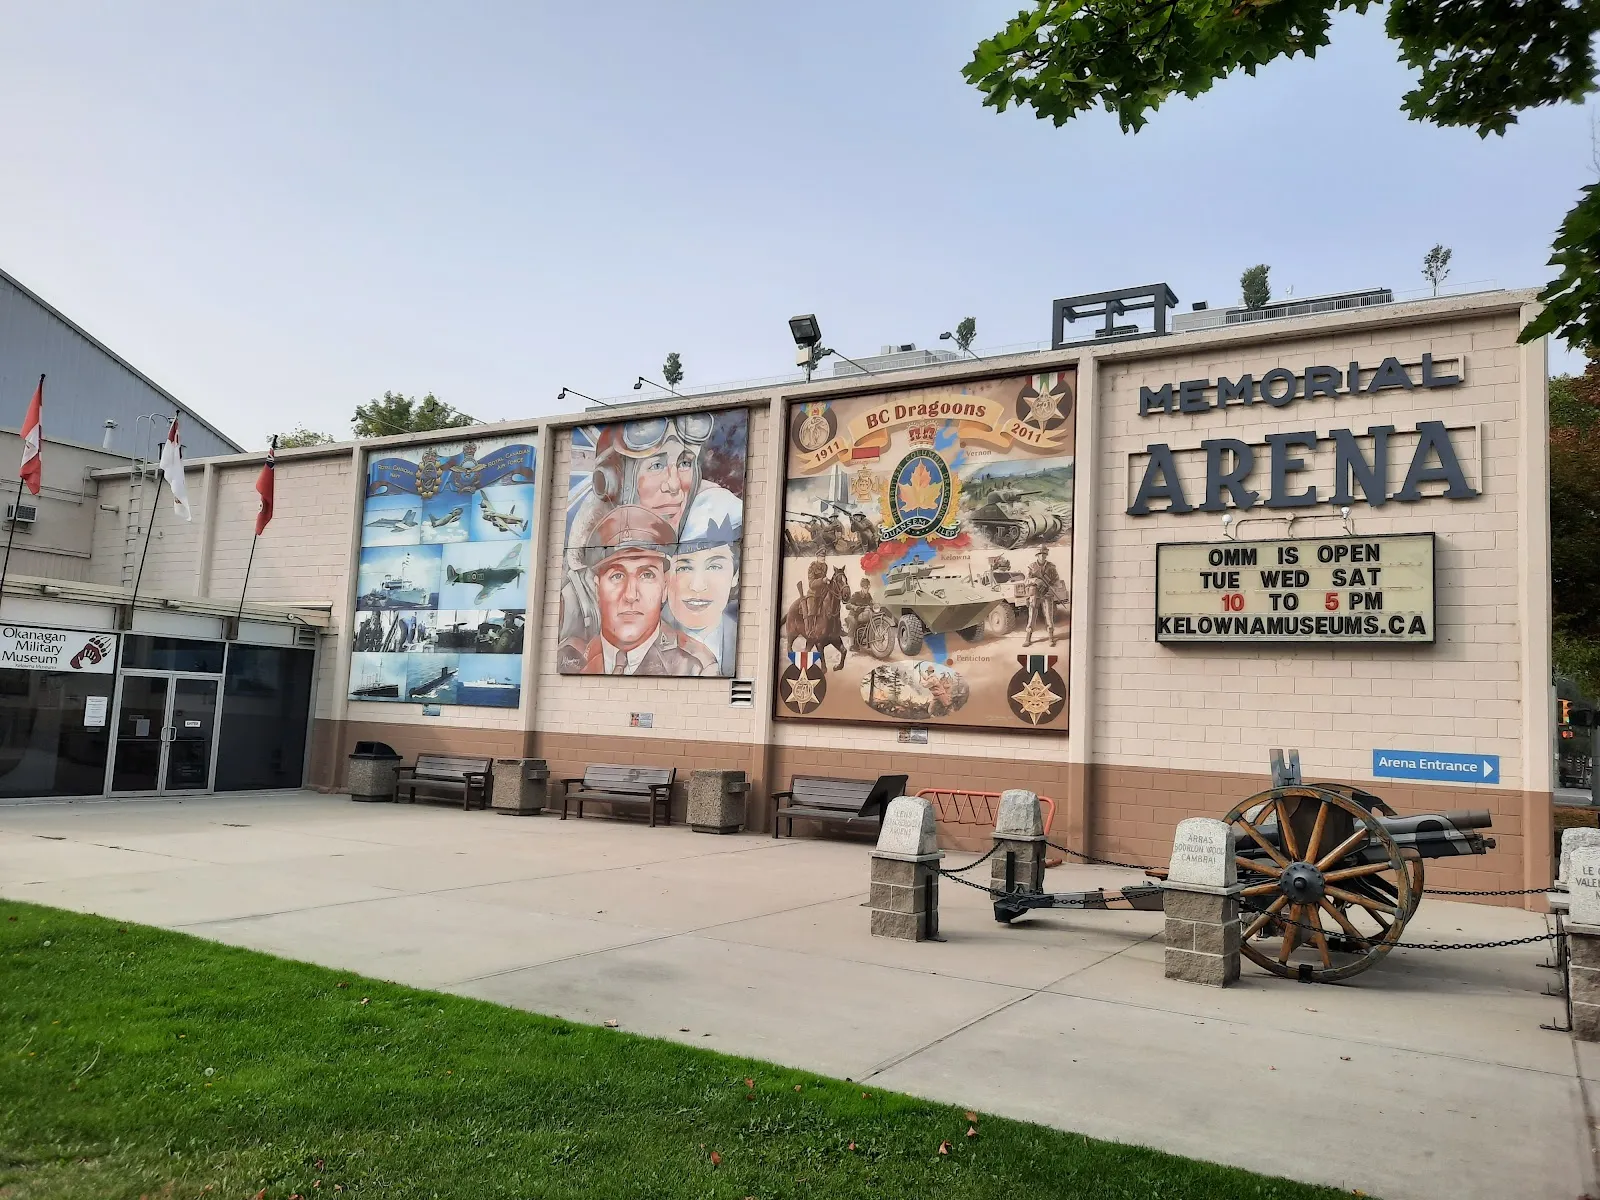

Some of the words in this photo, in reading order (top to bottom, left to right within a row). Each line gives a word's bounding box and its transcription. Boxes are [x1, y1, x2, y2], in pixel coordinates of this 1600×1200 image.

[1138, 353, 1460, 416] MEMORIAL
[866, 409, 890, 430] BC
[894, 401, 987, 420] Dragoons
[1011, 423, 1042, 443] 2011
[815, 441, 840, 462] 1911
[965, 449, 992, 457] Vernon
[1126, 421, 1481, 515] ARENA
[883, 519, 926, 539] QUANSEM
[940, 553, 971, 561] Kelowna
[1208, 548, 1257, 567] OMM
[1277, 547, 1299, 565] IS
[1317, 544, 1381, 563] OPEN
[1200, 571, 1240, 590] TUE
[1260, 570, 1310, 588] WED
[1332, 568, 1381, 587] SAT
[1222, 593, 1245, 612] 10
[1269, 593, 1299, 611] TO
[1325, 592, 1340, 611] 5
[1349, 592, 1383, 610] PM
[3, 627, 66, 643] Okanagan
[1157, 615, 1427, 635] KELOWNAMUSEUMS.CA
[2, 651, 57, 664] Museum
[15, 640, 62, 655] Military
[956, 654, 991, 662] Penticton
[1378, 756, 1416, 768] Arena
[1419, 759, 1478, 773] Entrance
[1583, 866, 1594, 875] LE
